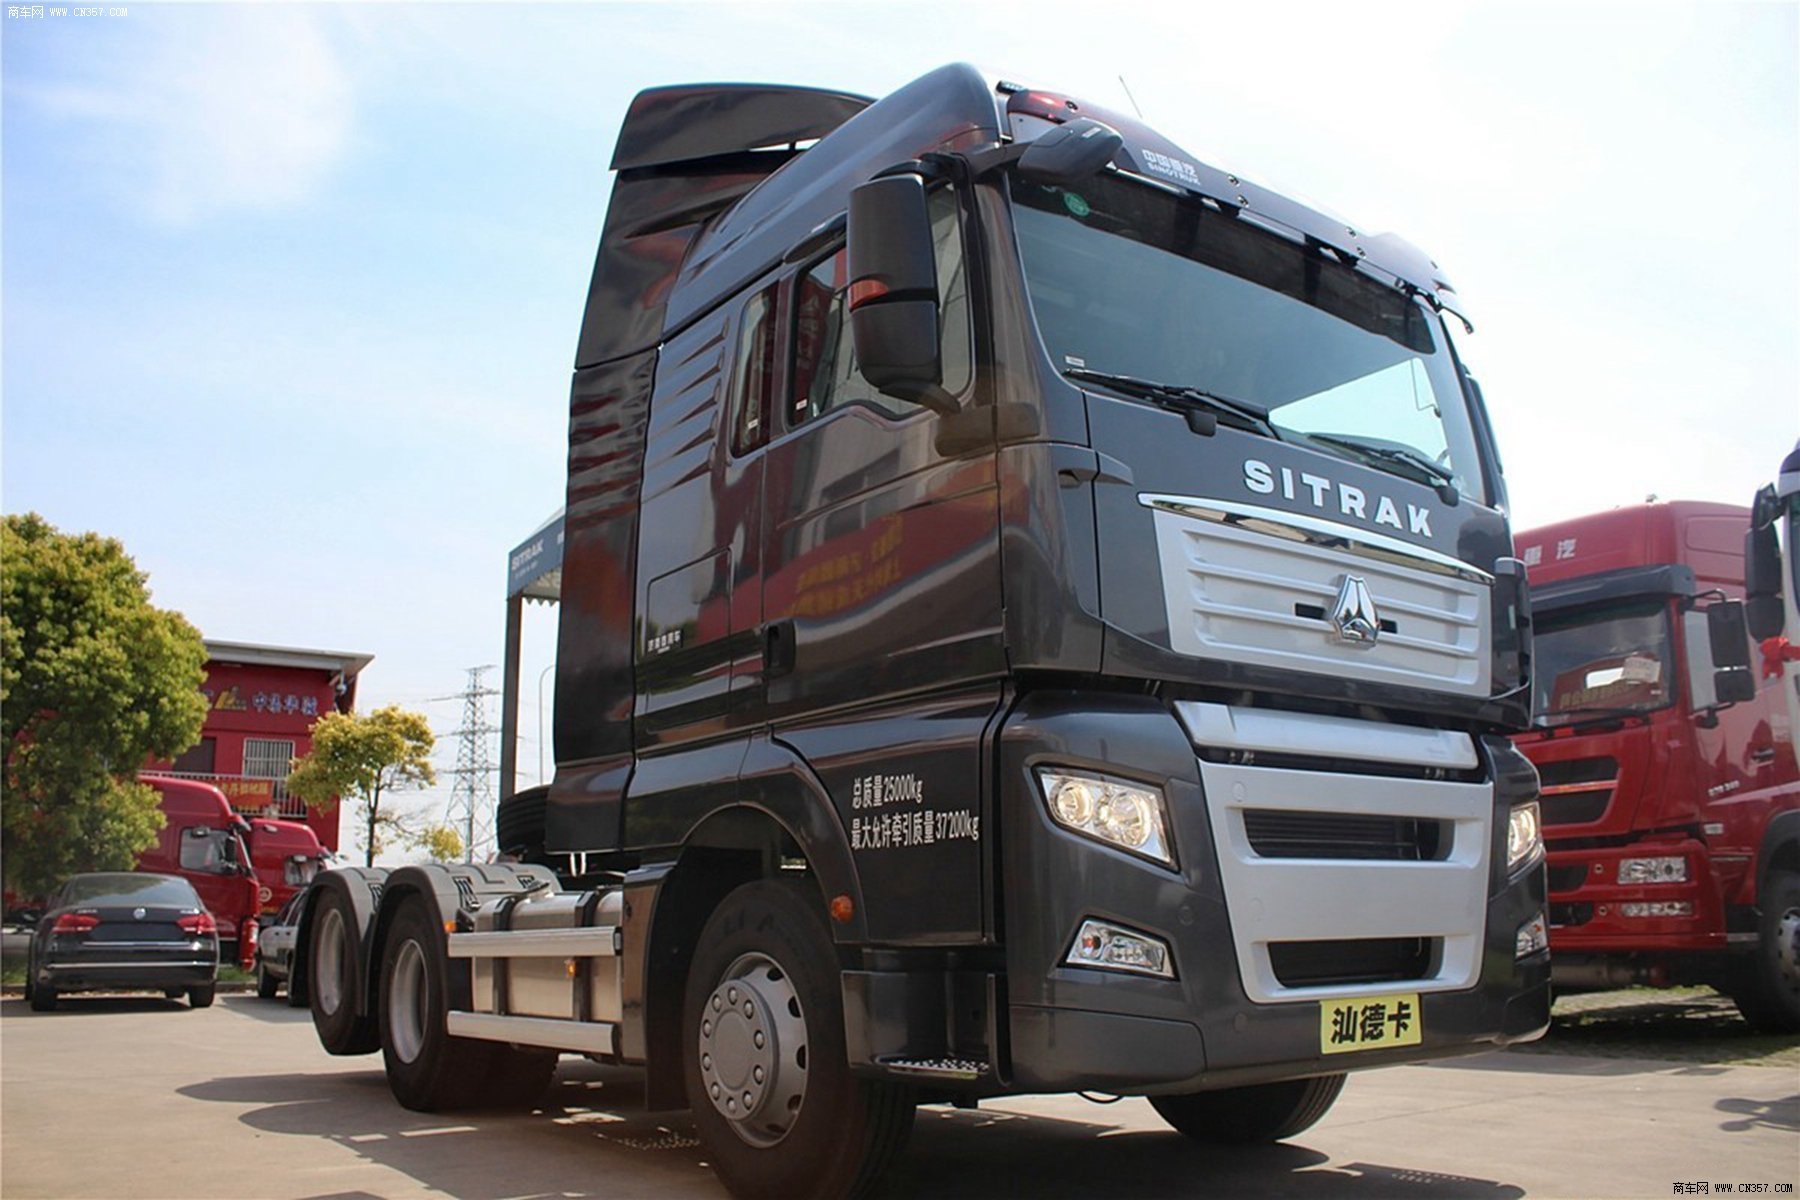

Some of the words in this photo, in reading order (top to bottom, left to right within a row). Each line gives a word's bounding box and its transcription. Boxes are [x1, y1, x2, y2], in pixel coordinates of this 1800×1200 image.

[1243, 459, 1433, 538] SITRAK
[852, 773, 924, 809] 总质量25000kg
[851, 810, 979, 850] 最大允许牵引质量37200kg
[1330, 1001, 1412, 1044] 汕德卡
